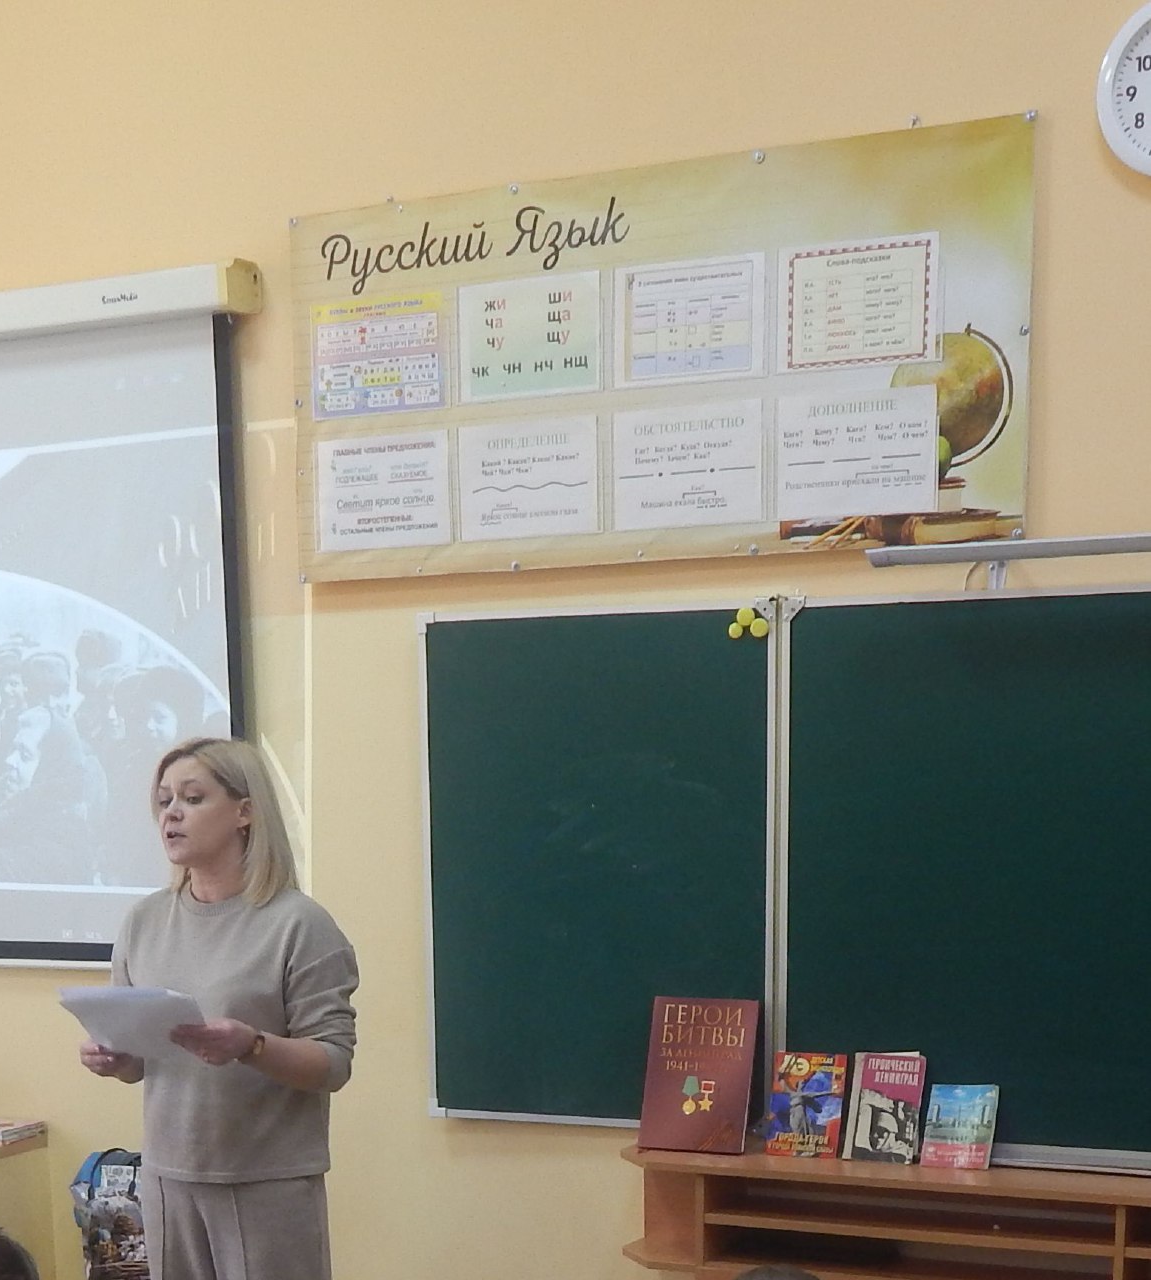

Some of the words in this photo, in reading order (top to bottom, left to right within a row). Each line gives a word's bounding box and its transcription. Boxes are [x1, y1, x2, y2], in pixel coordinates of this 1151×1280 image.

[1126, 86, 1137, 102] 9
[1134, 112, 1145, 129] 8
[321, 221, 492, 296] Русский
[505, 196, 630, 270] Язык
[485, 299, 506, 312] жи
[548, 291, 572, 304] ши
[485, 318, 503, 329] ча
[547, 309, 571, 324] ща
[486, 336, 504, 351] чу
[547, 330, 570, 345] щу
[664, 1004, 742, 1026] ГЕРОИ
[662, 1024, 745, 1047] БИТВЫ
[868, 1058, 920, 1072] ГЕРОИЧЕСКИЙ
[875, 1071, 919, 1086] ЛЕНИНГРАД
